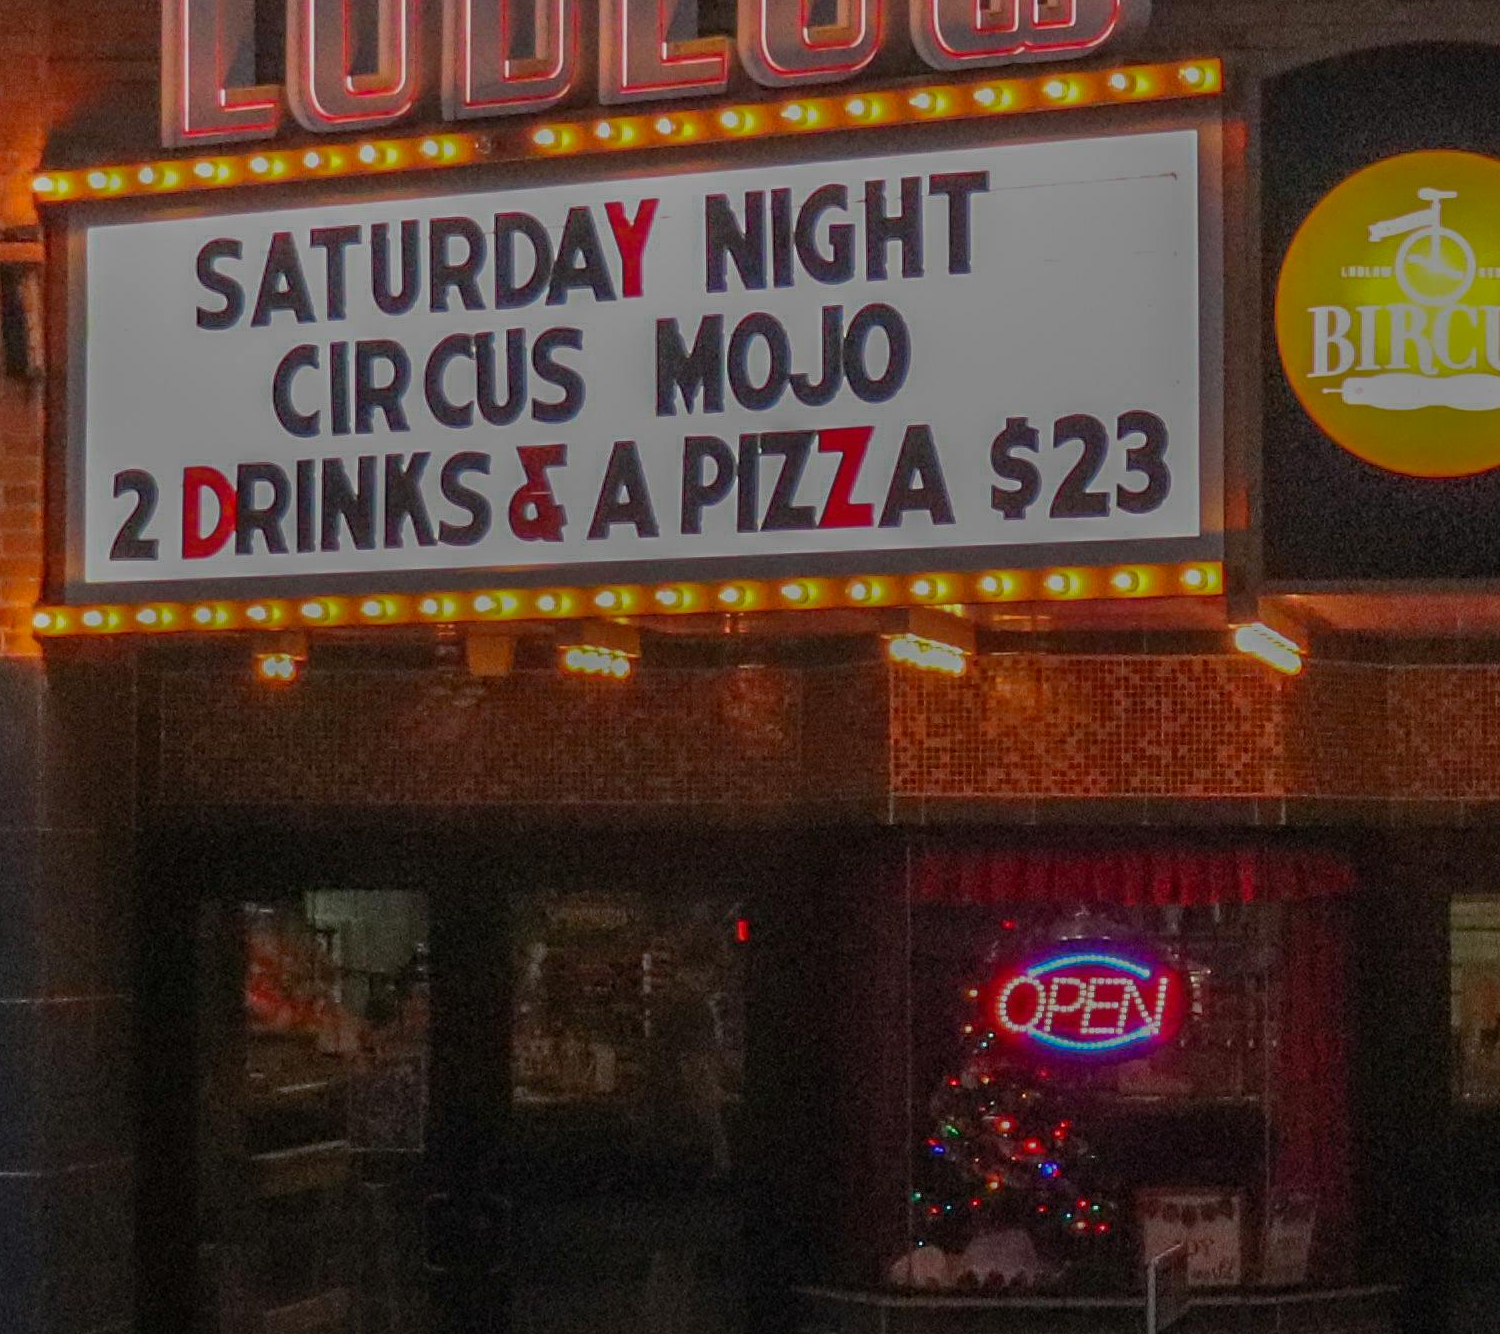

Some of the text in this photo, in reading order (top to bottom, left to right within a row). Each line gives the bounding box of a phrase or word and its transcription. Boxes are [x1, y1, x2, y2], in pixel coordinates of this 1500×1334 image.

[196, 171, 990, 330] SATURDAY NIGHT
[273, 303, 910, 437] CIRCUS MOJO
[110, 410, 1172, 560] 2 DRINKS & A PIZZA $23
[996, 975, 1168, 1036] OPEN
